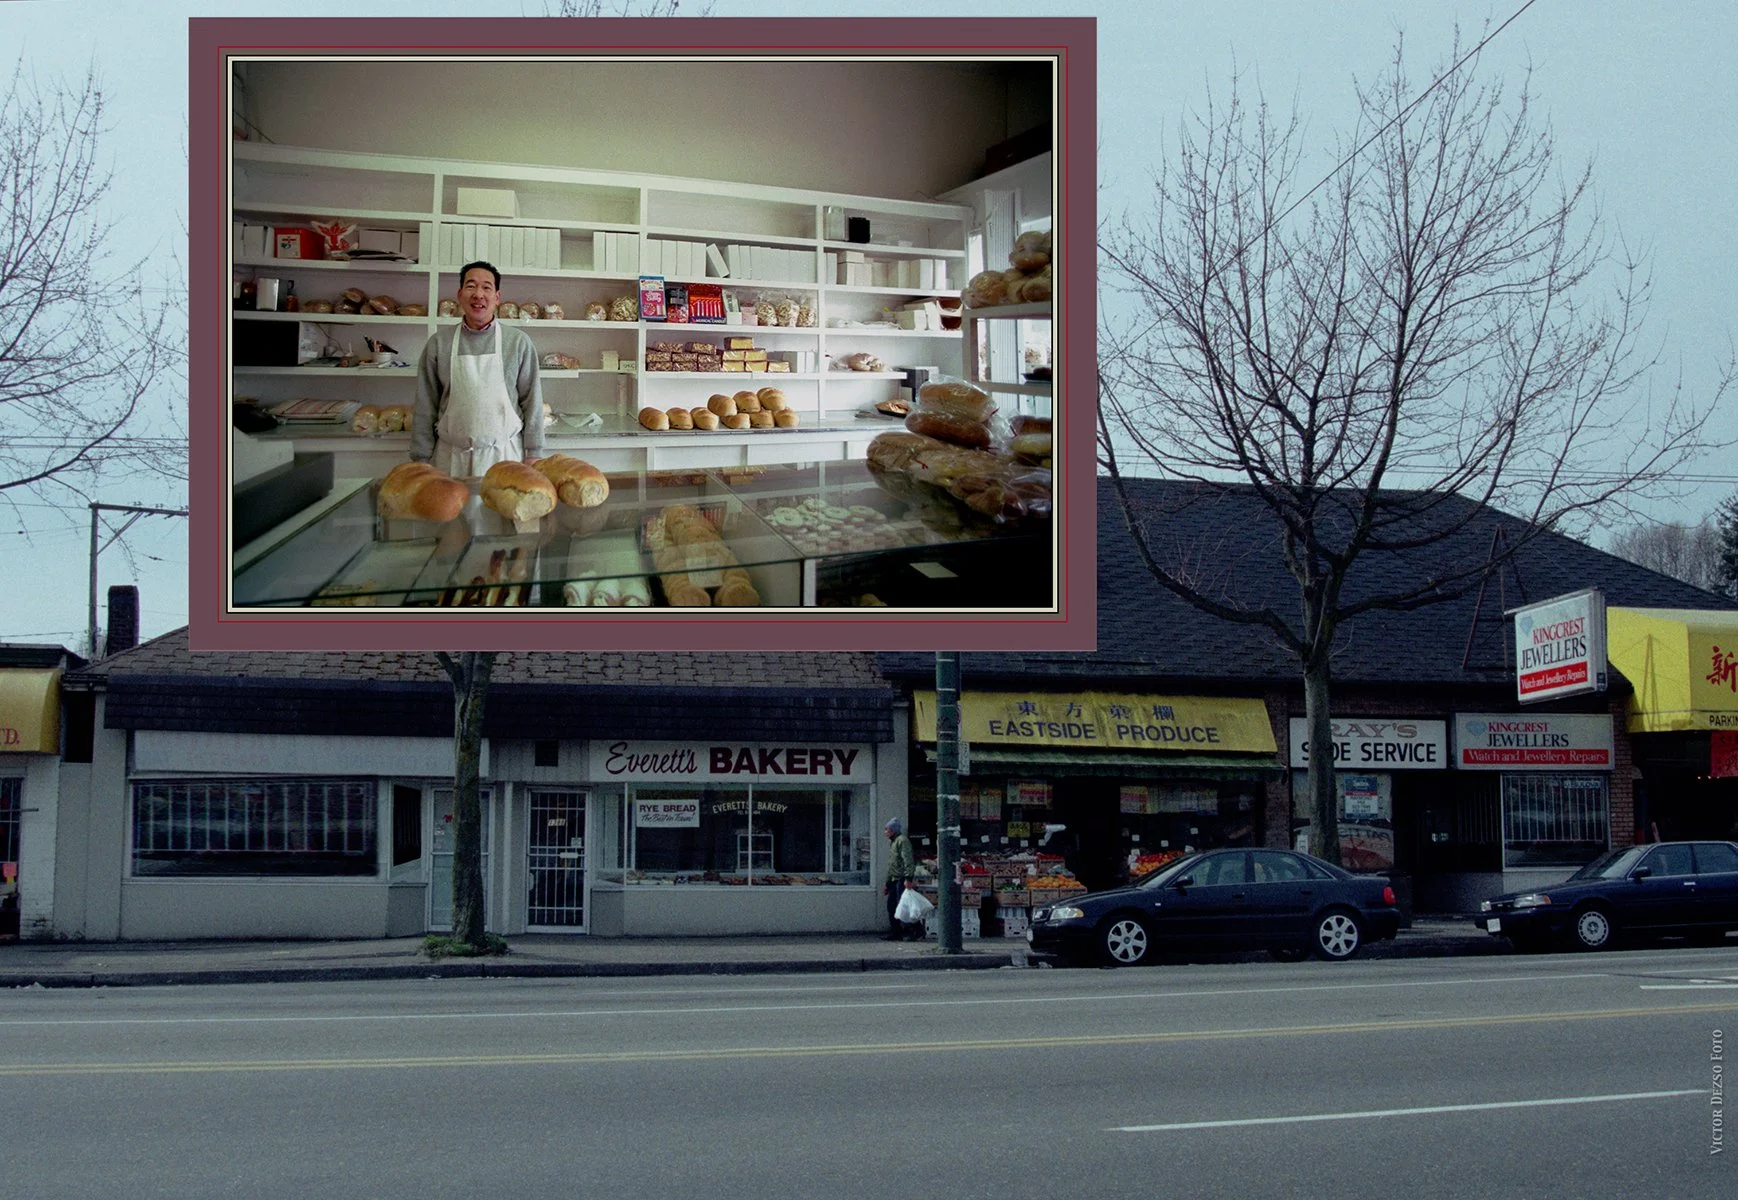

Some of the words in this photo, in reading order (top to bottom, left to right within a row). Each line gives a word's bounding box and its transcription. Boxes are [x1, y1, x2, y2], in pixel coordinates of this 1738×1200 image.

[1533, 617, 1585, 645] KINGCREST
[1521, 636, 1587, 670] JEWELLERS
[1521, 677, 1535, 689] Watch
[1545, 671, 1567, 685] Jewellery
[1567, 668, 1586, 682] Repairs
[989, 720, 1097, 740] EASTSIDE
[1116, 723, 1220, 744] PRODUCE
[1488, 722, 1549, 733] KINGCREST
[1487, 733, 1569, 748] JEWELLERS
[605, 741, 698, 775] Everett's
[709, 748, 860, 776] BAKERY
[1301, 742, 1352, 762] SOE
[1361, 742, 1437, 763] SERVICE
[1468, 751, 1500, 763] Watch
[1502, 751, 1520, 763] and
[1522, 751, 1567, 766] Jewellery
[1569, 752, 1606, 765] Repairs
[639, 804, 659, 813] RYE
[663, 804, 696, 813] BREAD
[757, 801, 788, 813] BAKERY
